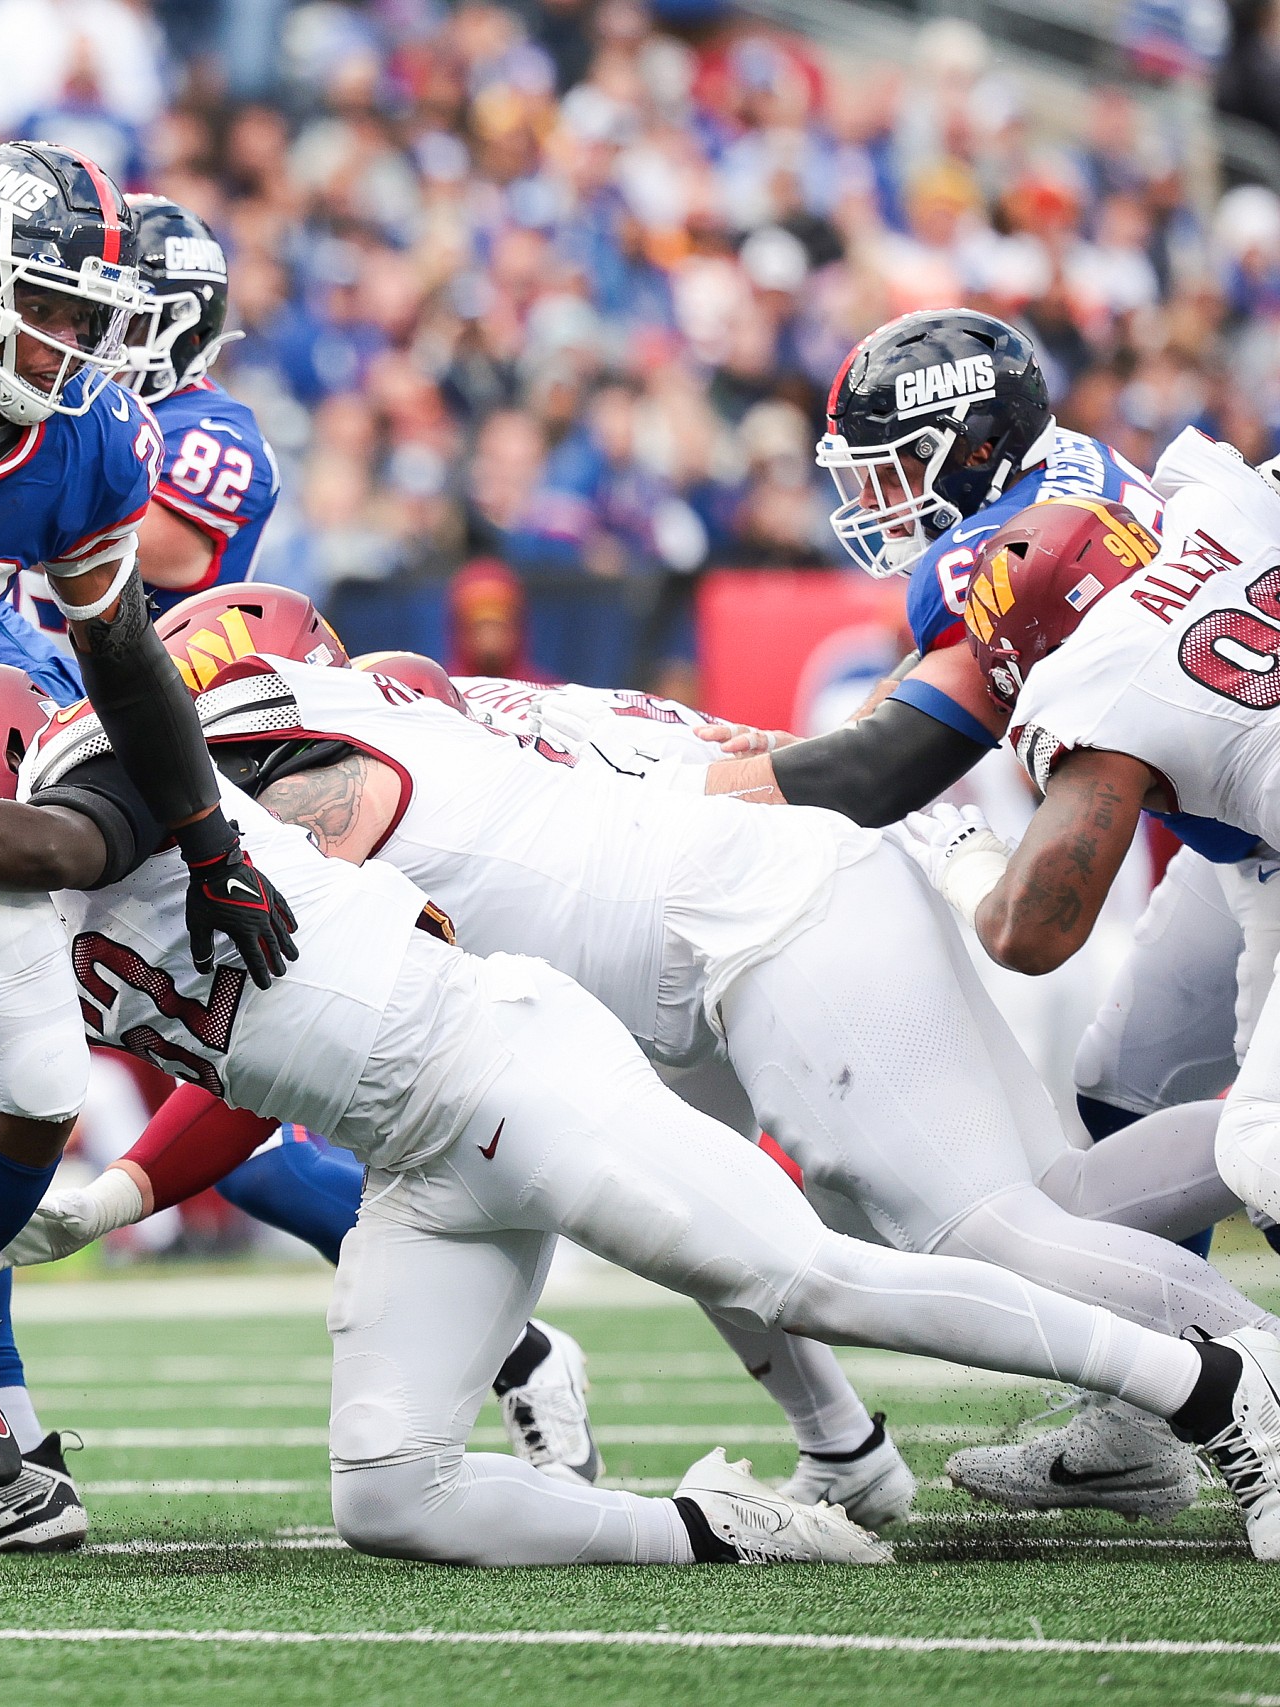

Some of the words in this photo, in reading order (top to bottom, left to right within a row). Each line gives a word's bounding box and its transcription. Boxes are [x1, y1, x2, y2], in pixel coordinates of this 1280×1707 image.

[895, 354, 996, 411] GIANTS
[171, 429, 253, 514] 82
[1102, 521, 1159, 568] 93
